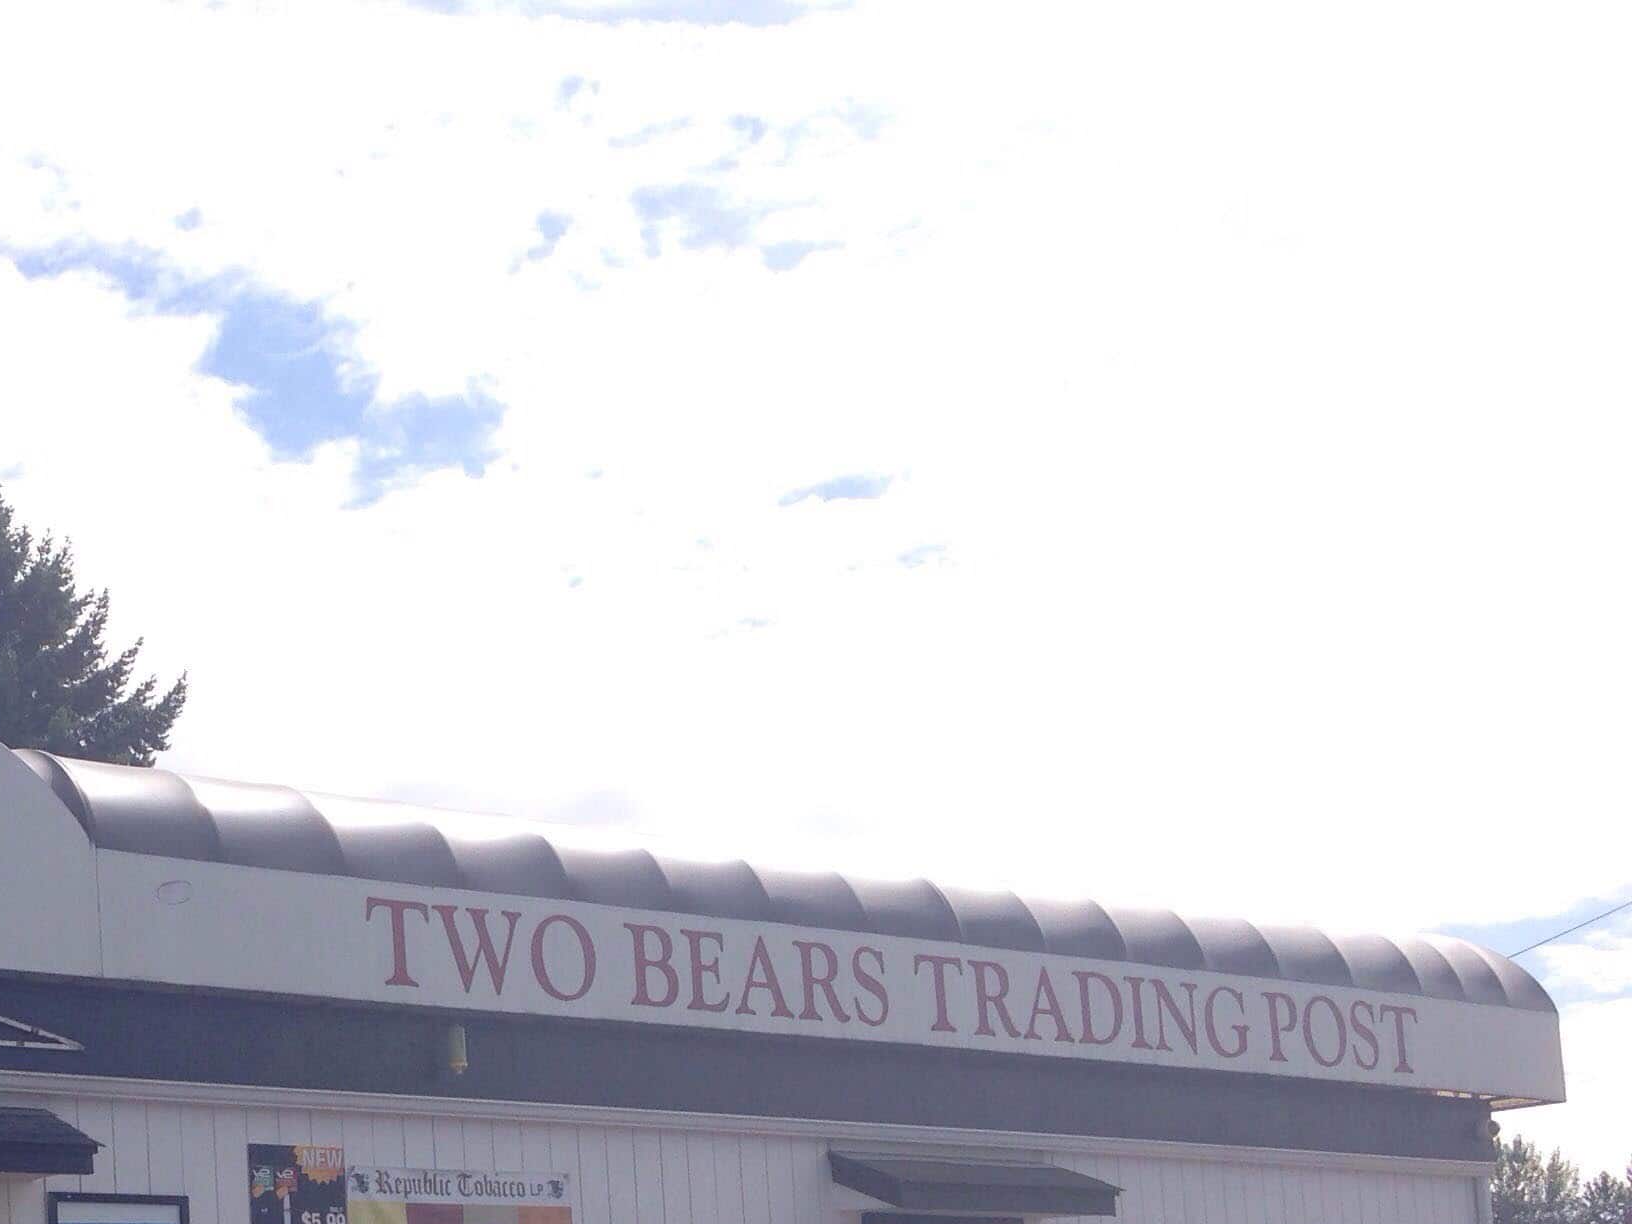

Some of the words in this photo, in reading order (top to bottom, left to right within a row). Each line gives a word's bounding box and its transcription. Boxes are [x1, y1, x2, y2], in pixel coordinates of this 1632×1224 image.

[366, 896, 598, 1001] TWO
[622, 922, 890, 1028] BEARS
[914, 954, 1250, 1060] TRADING
[1268, 991, 1419, 1076] POST
[302, 1149, 344, 1169] NEW
[374, 1169, 452, 1200] Republic
[456, 1173, 526, 1198] Tobacco
